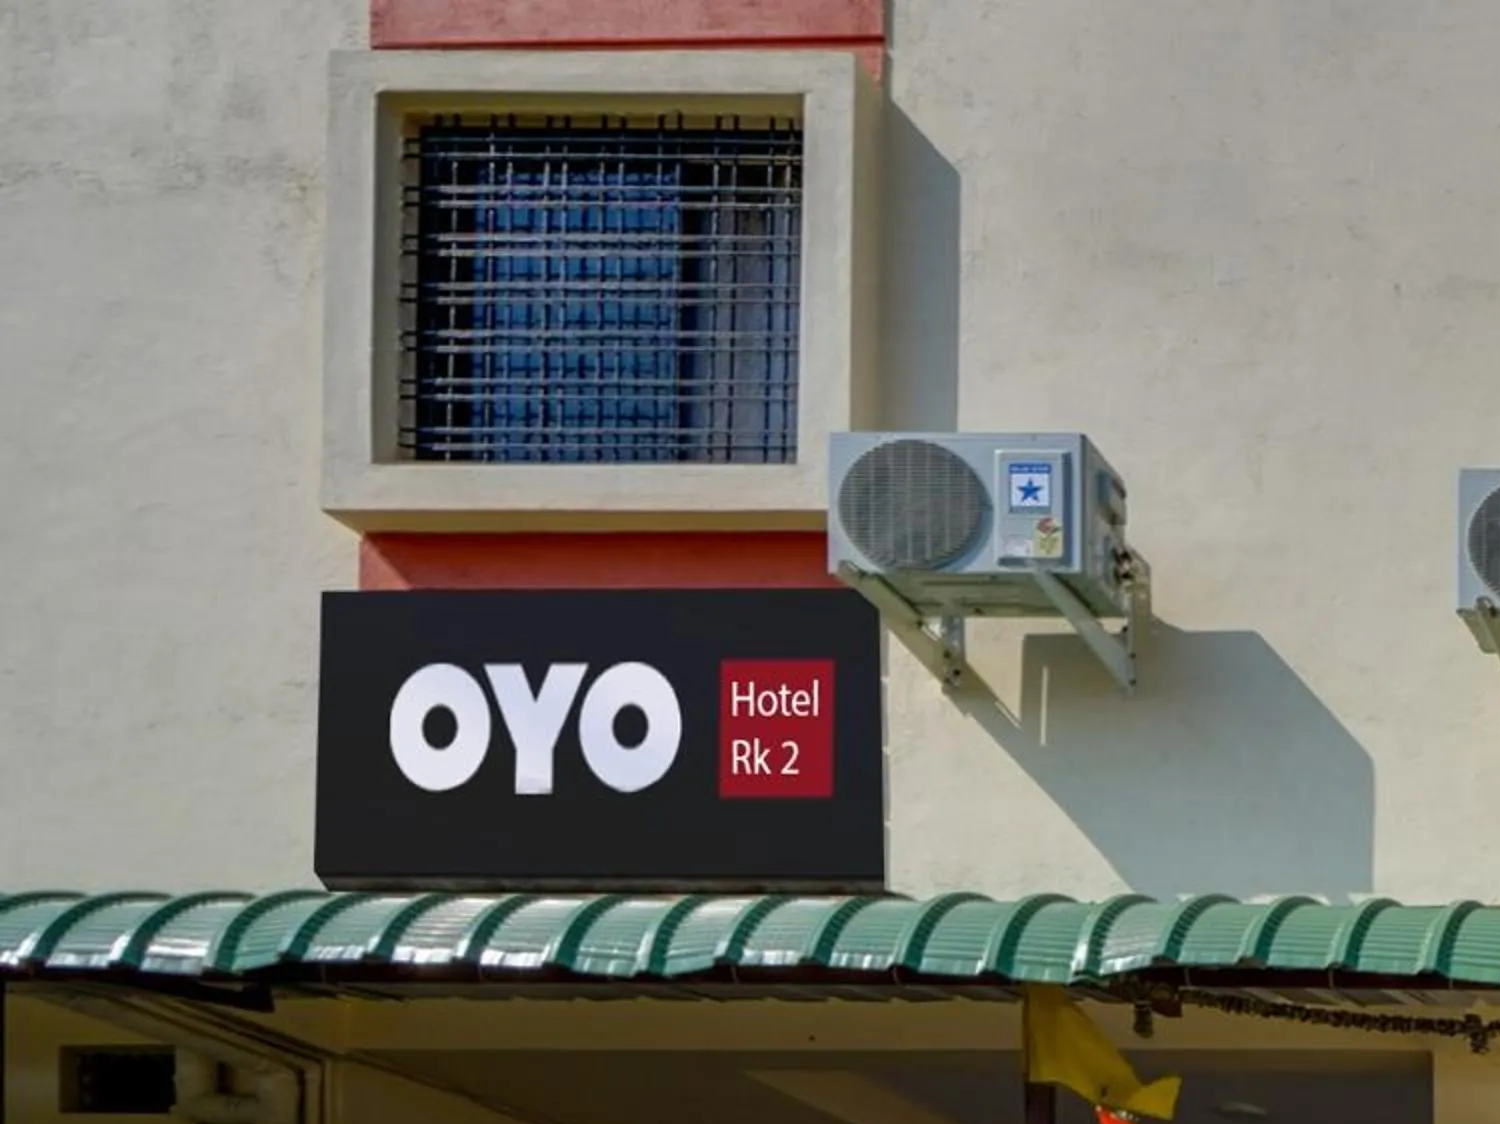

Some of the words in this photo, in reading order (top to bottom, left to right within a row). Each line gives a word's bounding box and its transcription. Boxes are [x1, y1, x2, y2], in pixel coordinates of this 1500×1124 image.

[730, 679, 820, 718] Hotel
[389, 662, 682, 795] OYO
[731, 738, 770, 775] Rk
[780, 740, 800, 775] 2
